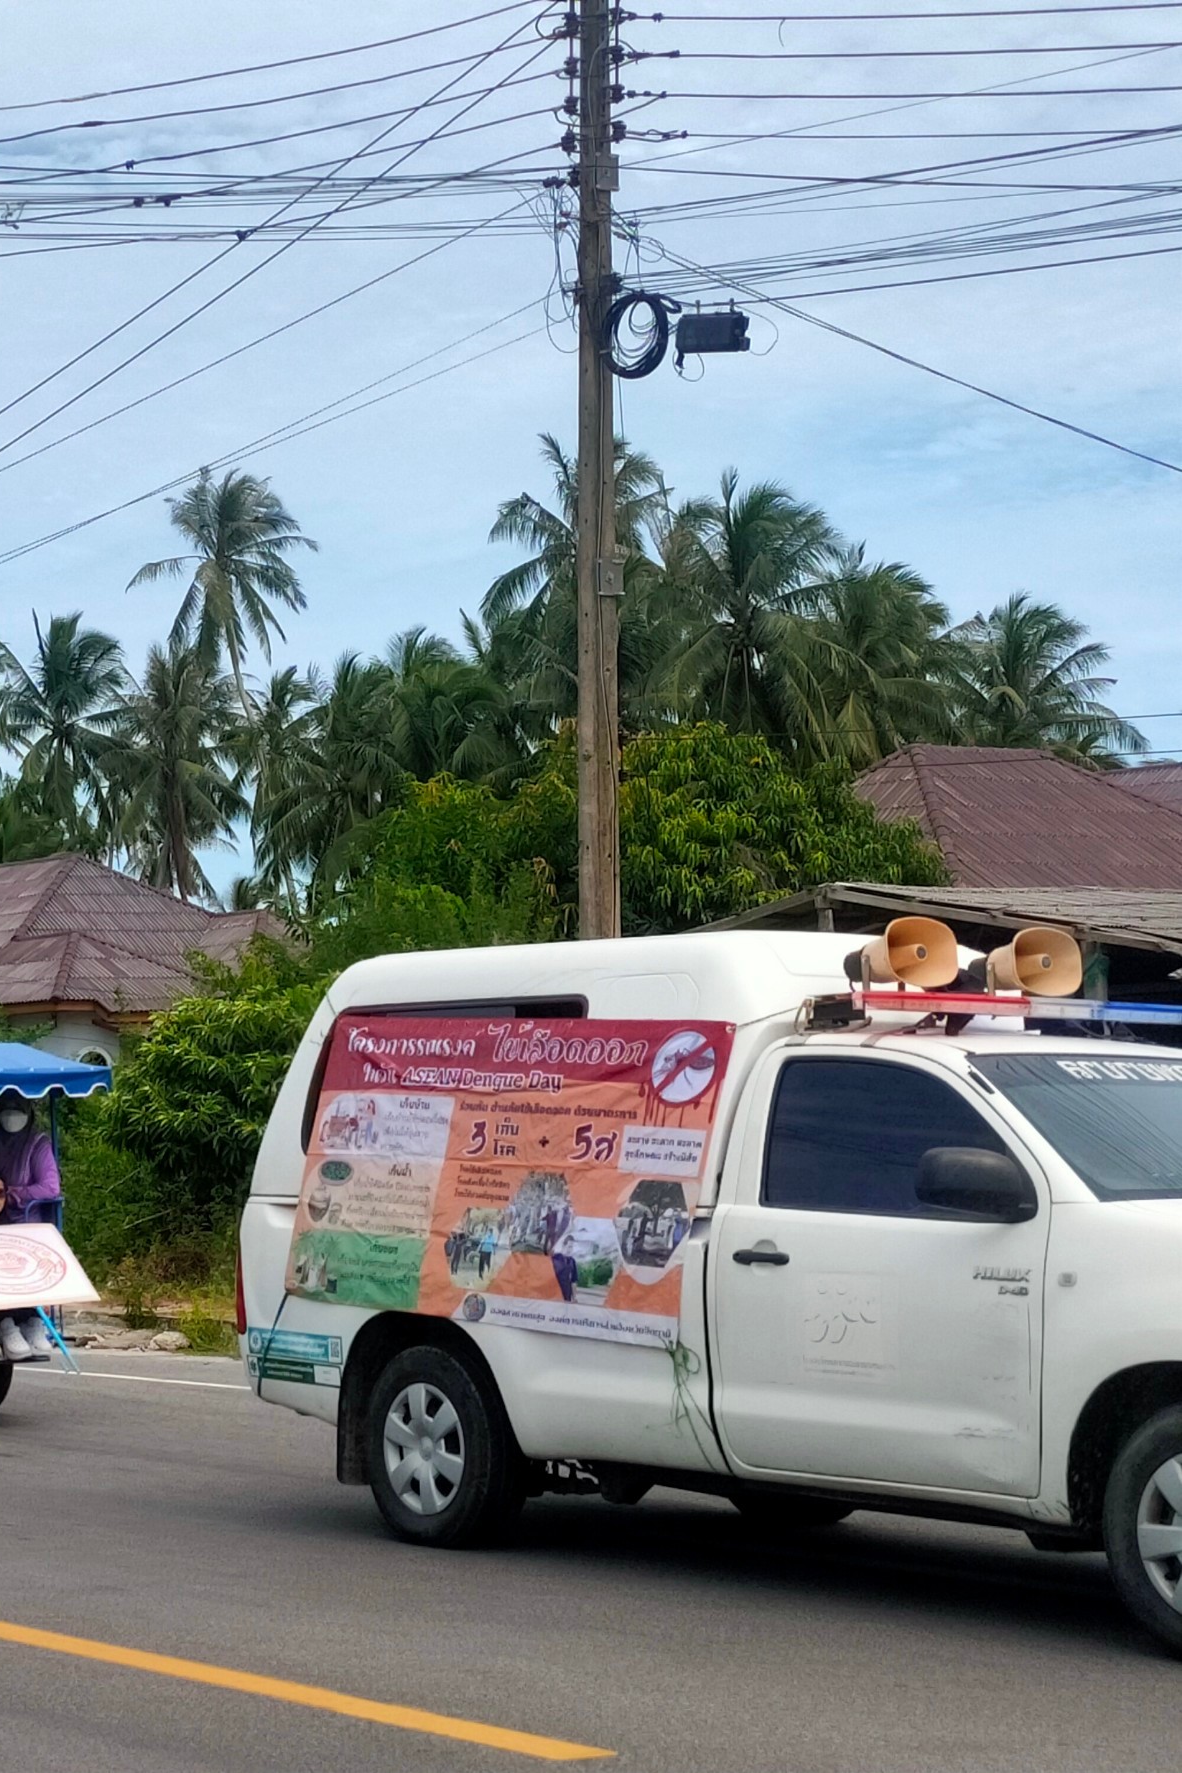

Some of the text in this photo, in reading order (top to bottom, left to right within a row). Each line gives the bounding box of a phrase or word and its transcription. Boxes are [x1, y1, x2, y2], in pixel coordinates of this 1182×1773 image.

[488, 1021, 648, 1066] ไข้เลือดออก
[401, 1066, 460, 1087] ASEAN
[460, 1068, 525, 1093] Dengue
[529, 1070, 563, 1095] Day
[465, 1120, 487, 1155] 3
[495, 1117, 519, 1135] เก็บ
[570, 1123, 618, 1162] 5ส
[493, 1139, 516, 1155] โรค
[973, 1266, 1031, 1282] HILUX
